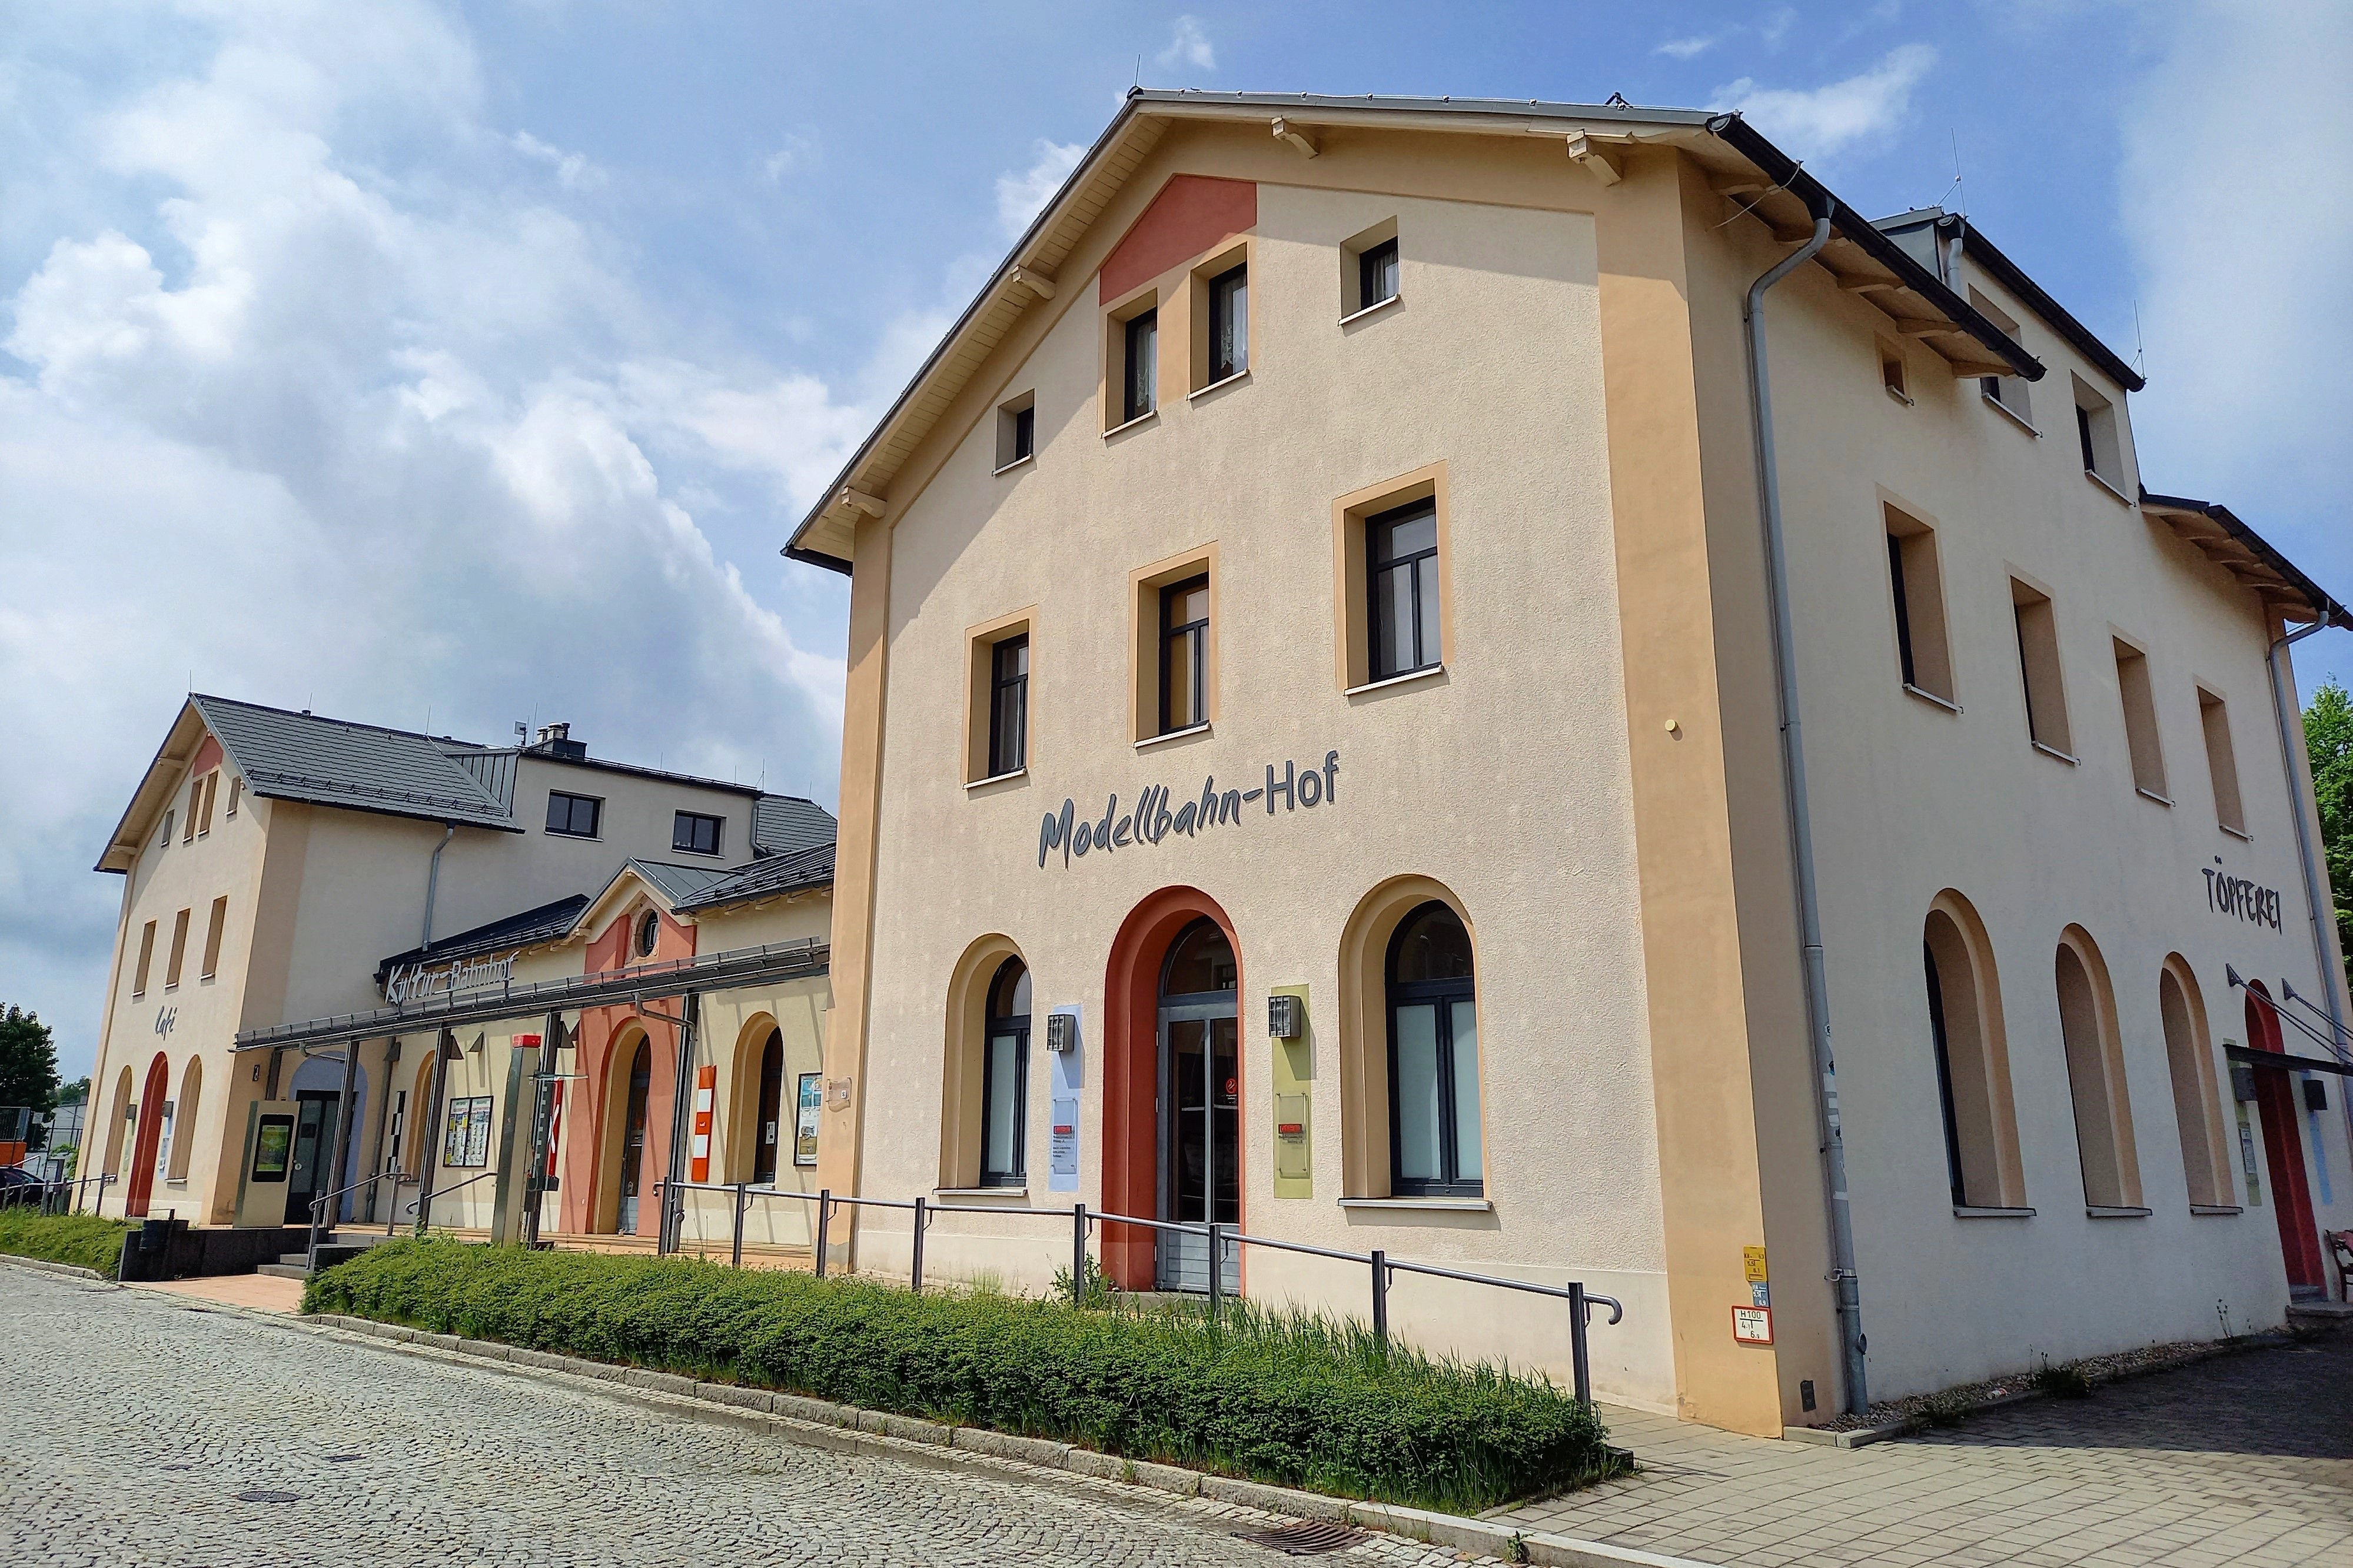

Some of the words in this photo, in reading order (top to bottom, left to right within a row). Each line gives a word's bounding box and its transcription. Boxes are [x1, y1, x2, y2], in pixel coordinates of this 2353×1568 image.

[1039, 750, 1339, 870] Modellbahn-Hof
[2201, 855, 2282, 936] TÖPFEREI
[384, 950, 520, 1004] Kultur-Bahnhof
